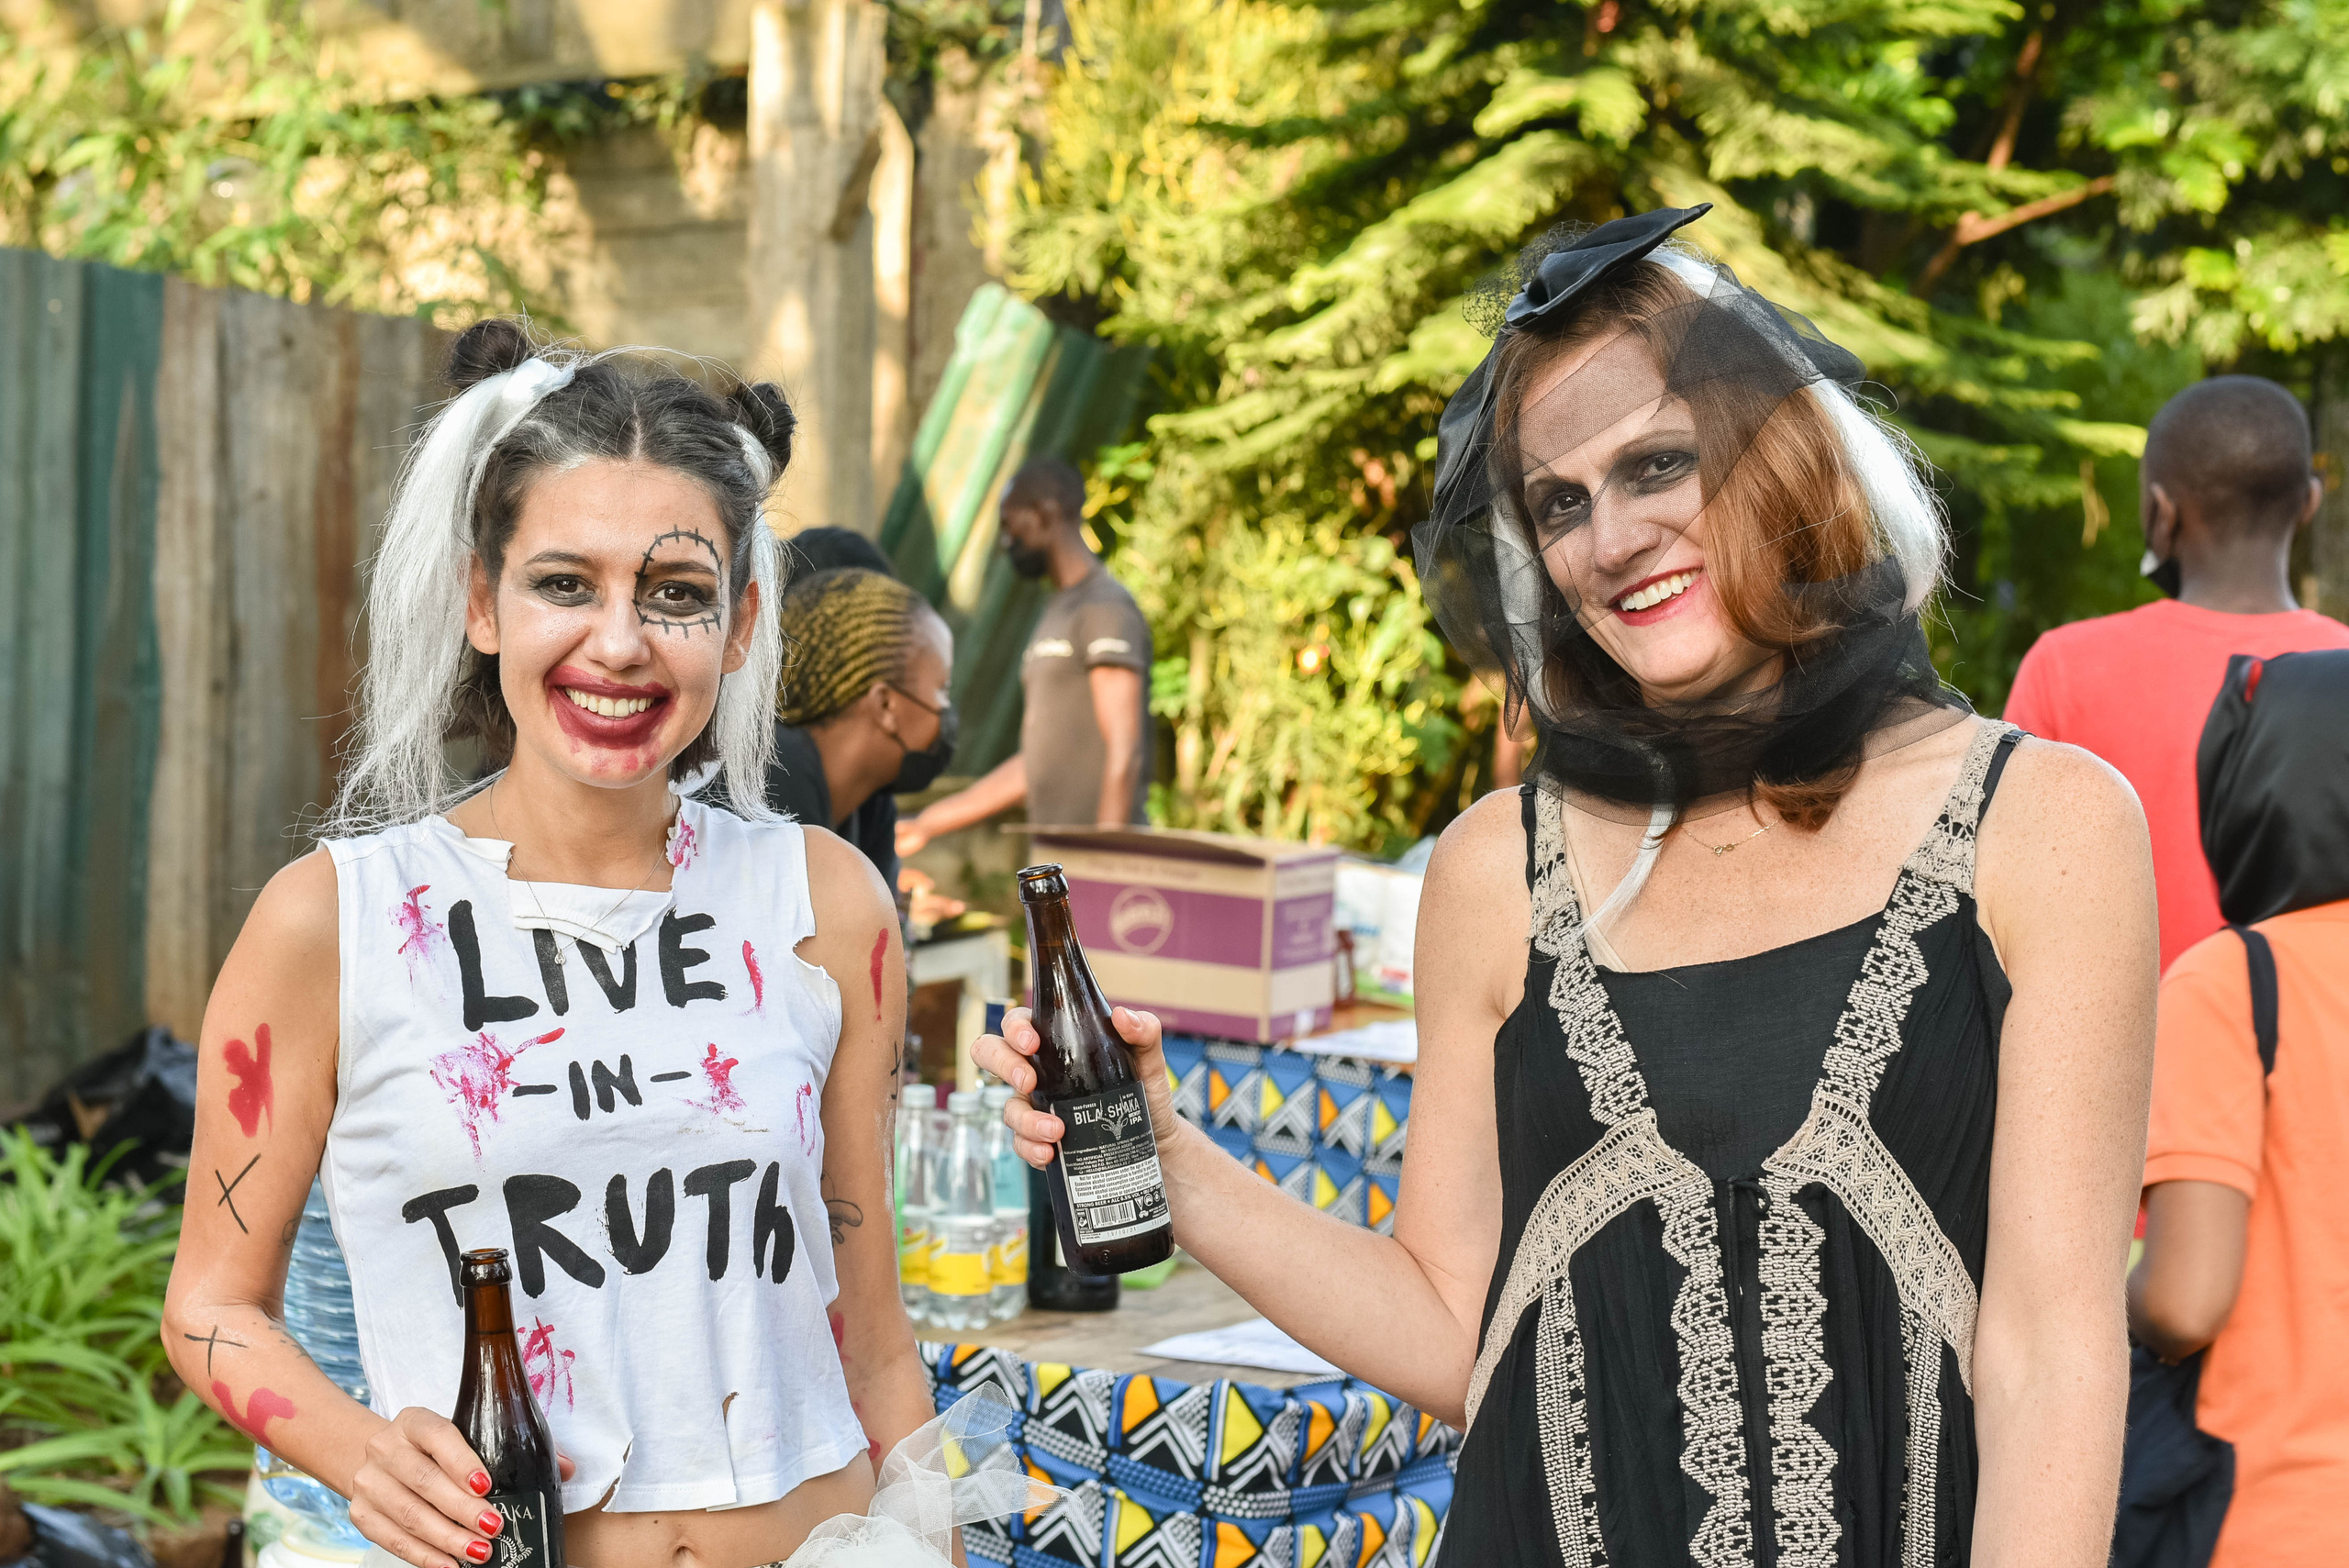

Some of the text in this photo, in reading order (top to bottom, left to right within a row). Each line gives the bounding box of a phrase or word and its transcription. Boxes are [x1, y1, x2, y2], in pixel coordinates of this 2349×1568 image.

[448, 899, 729, 1031] LIVE
[1074, 1097, 1141, 1125] BILA SHAKA
[1130, 1116, 1142, 1125] IPA
[1106, 1173, 1128, 1182] consumption
[1107, 1179, 1129, 1187] consumption
[1108, 1184, 1130, 1192] consumption
